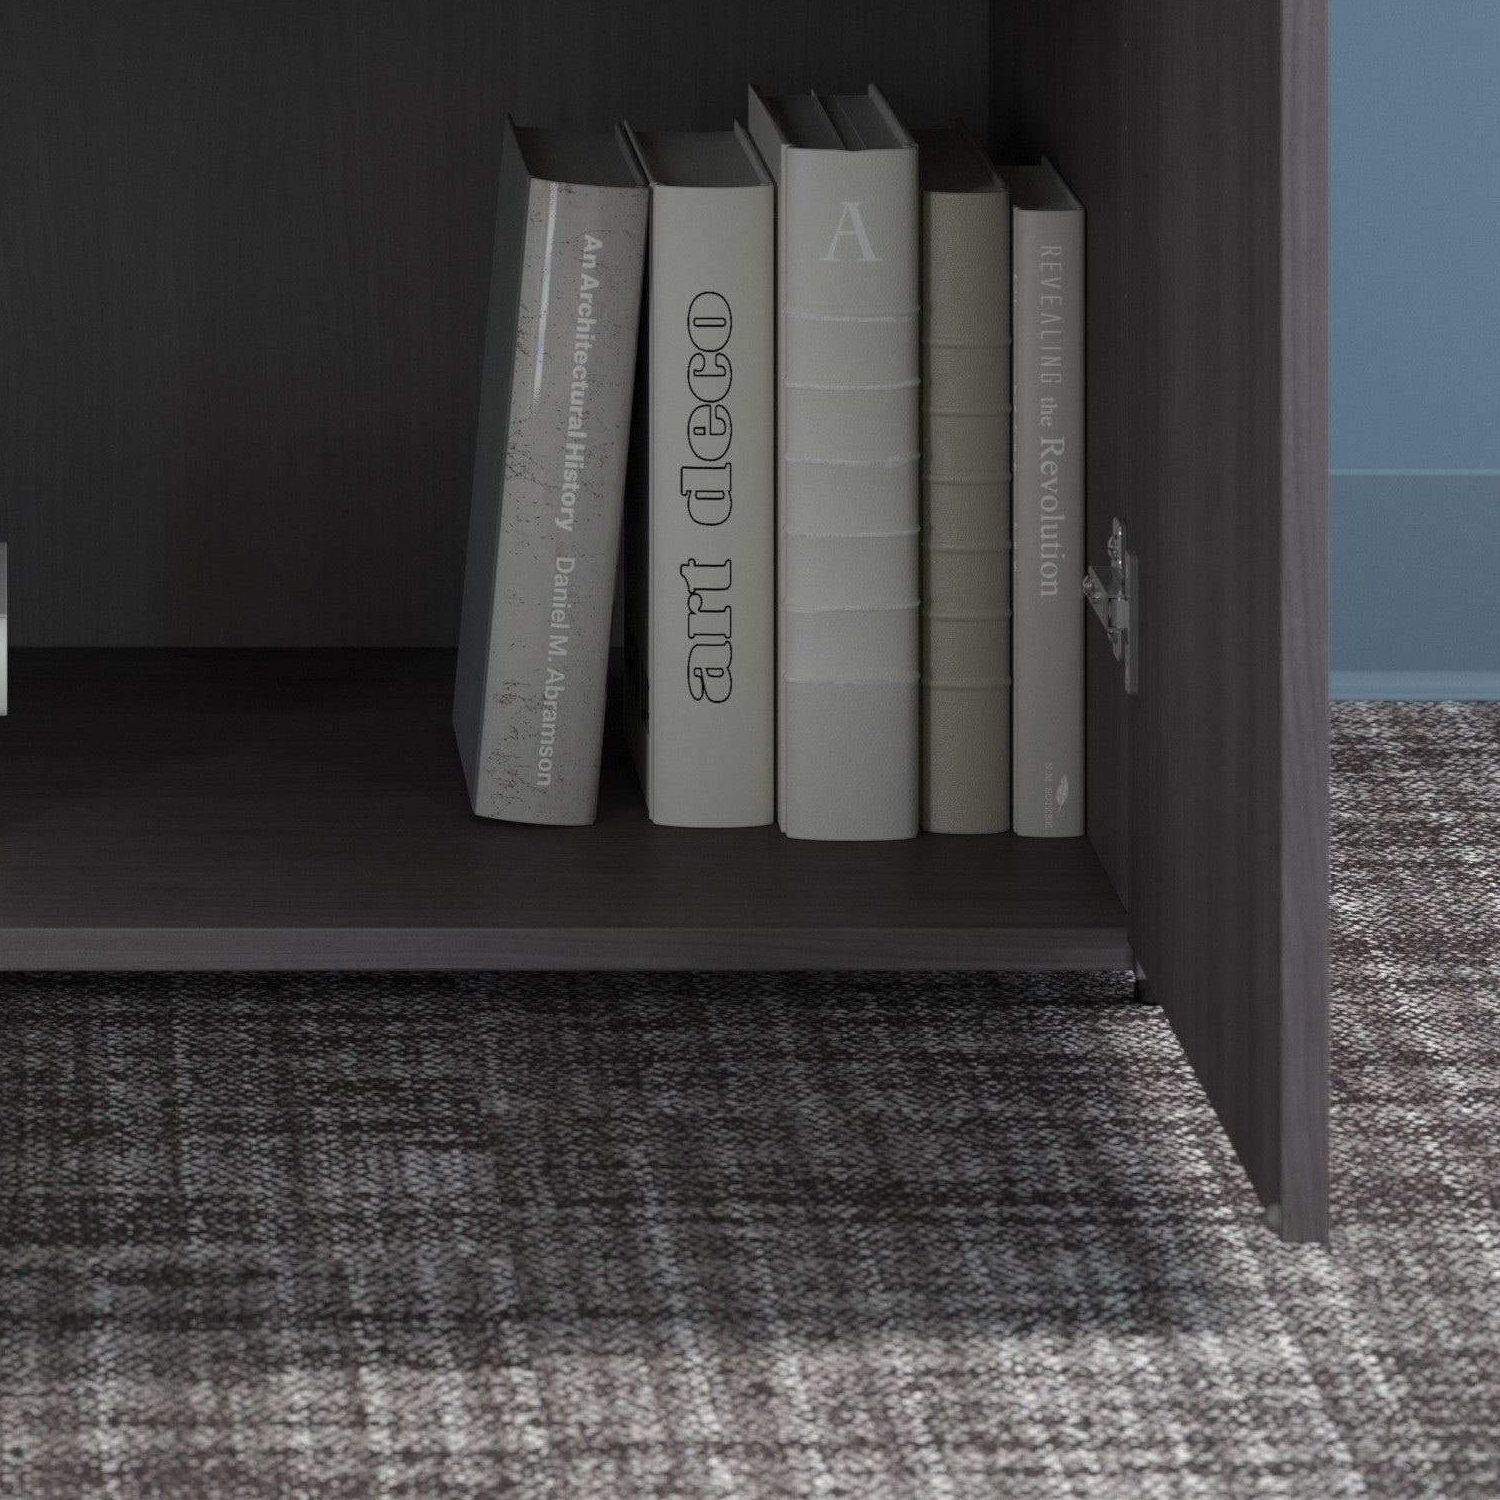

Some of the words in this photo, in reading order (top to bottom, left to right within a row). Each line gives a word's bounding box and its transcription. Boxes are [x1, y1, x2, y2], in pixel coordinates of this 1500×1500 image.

[580, 232, 604, 269] An
[819, 200, 882, 262] A
[564, 272, 601, 439] Architectural
[1039, 245, 1063, 384] REVEALING
[680, 291, 733, 526] deco
[1039, 396, 1060, 428] the
[554, 443, 586, 533] History
[1039, 436, 1066, 598] Revolution
[550, 555, 576, 629] Daniel
[680, 558, 732, 704] art
[546, 635, 568, 662] M.
[536, 667, 567, 788] Abramson
